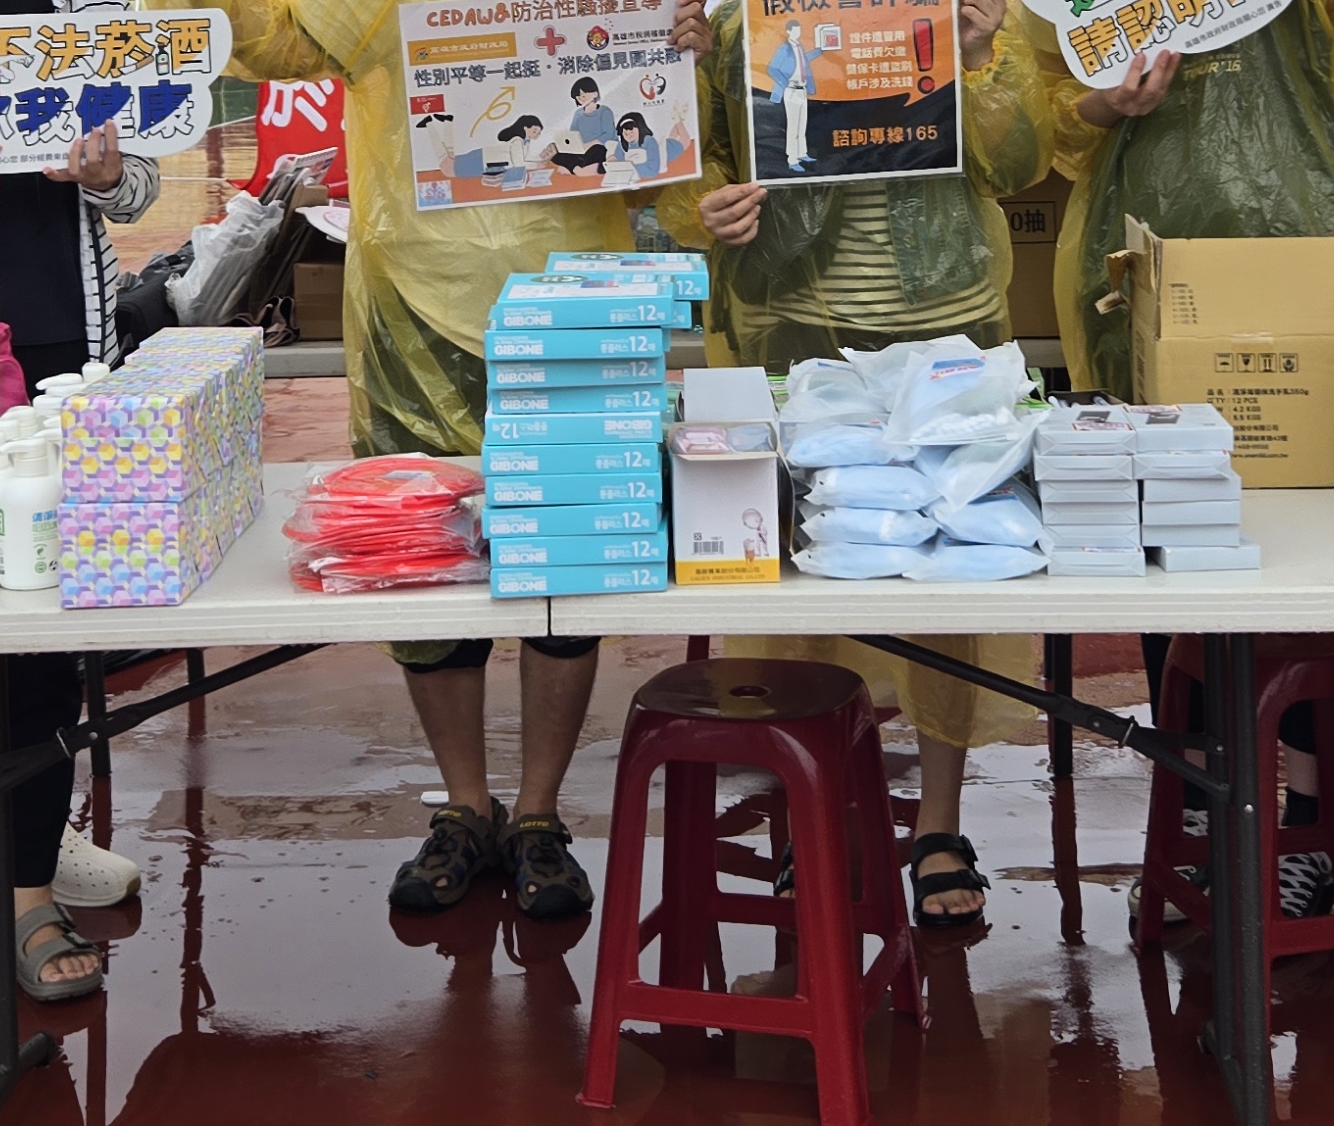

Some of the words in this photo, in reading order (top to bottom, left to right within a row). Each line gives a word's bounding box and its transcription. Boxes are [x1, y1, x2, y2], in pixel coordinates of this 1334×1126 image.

[833, 125, 938, 147] 諮詢專線165
[503, 315, 552, 326] GIBONE
[494, 344, 543, 356] GIBONE
[496, 372, 545, 383] GIBONE
[500, 399, 548, 410] GIBONE
[490, 460, 538, 471] GIBONE
[494, 490, 543, 501] GIBONE
[490, 523, 538, 534] GIBONE
[498, 552, 547, 564] GIBONE
[498, 581, 547, 592] GIBONE
[520, 820, 549, 828] LOTTO
